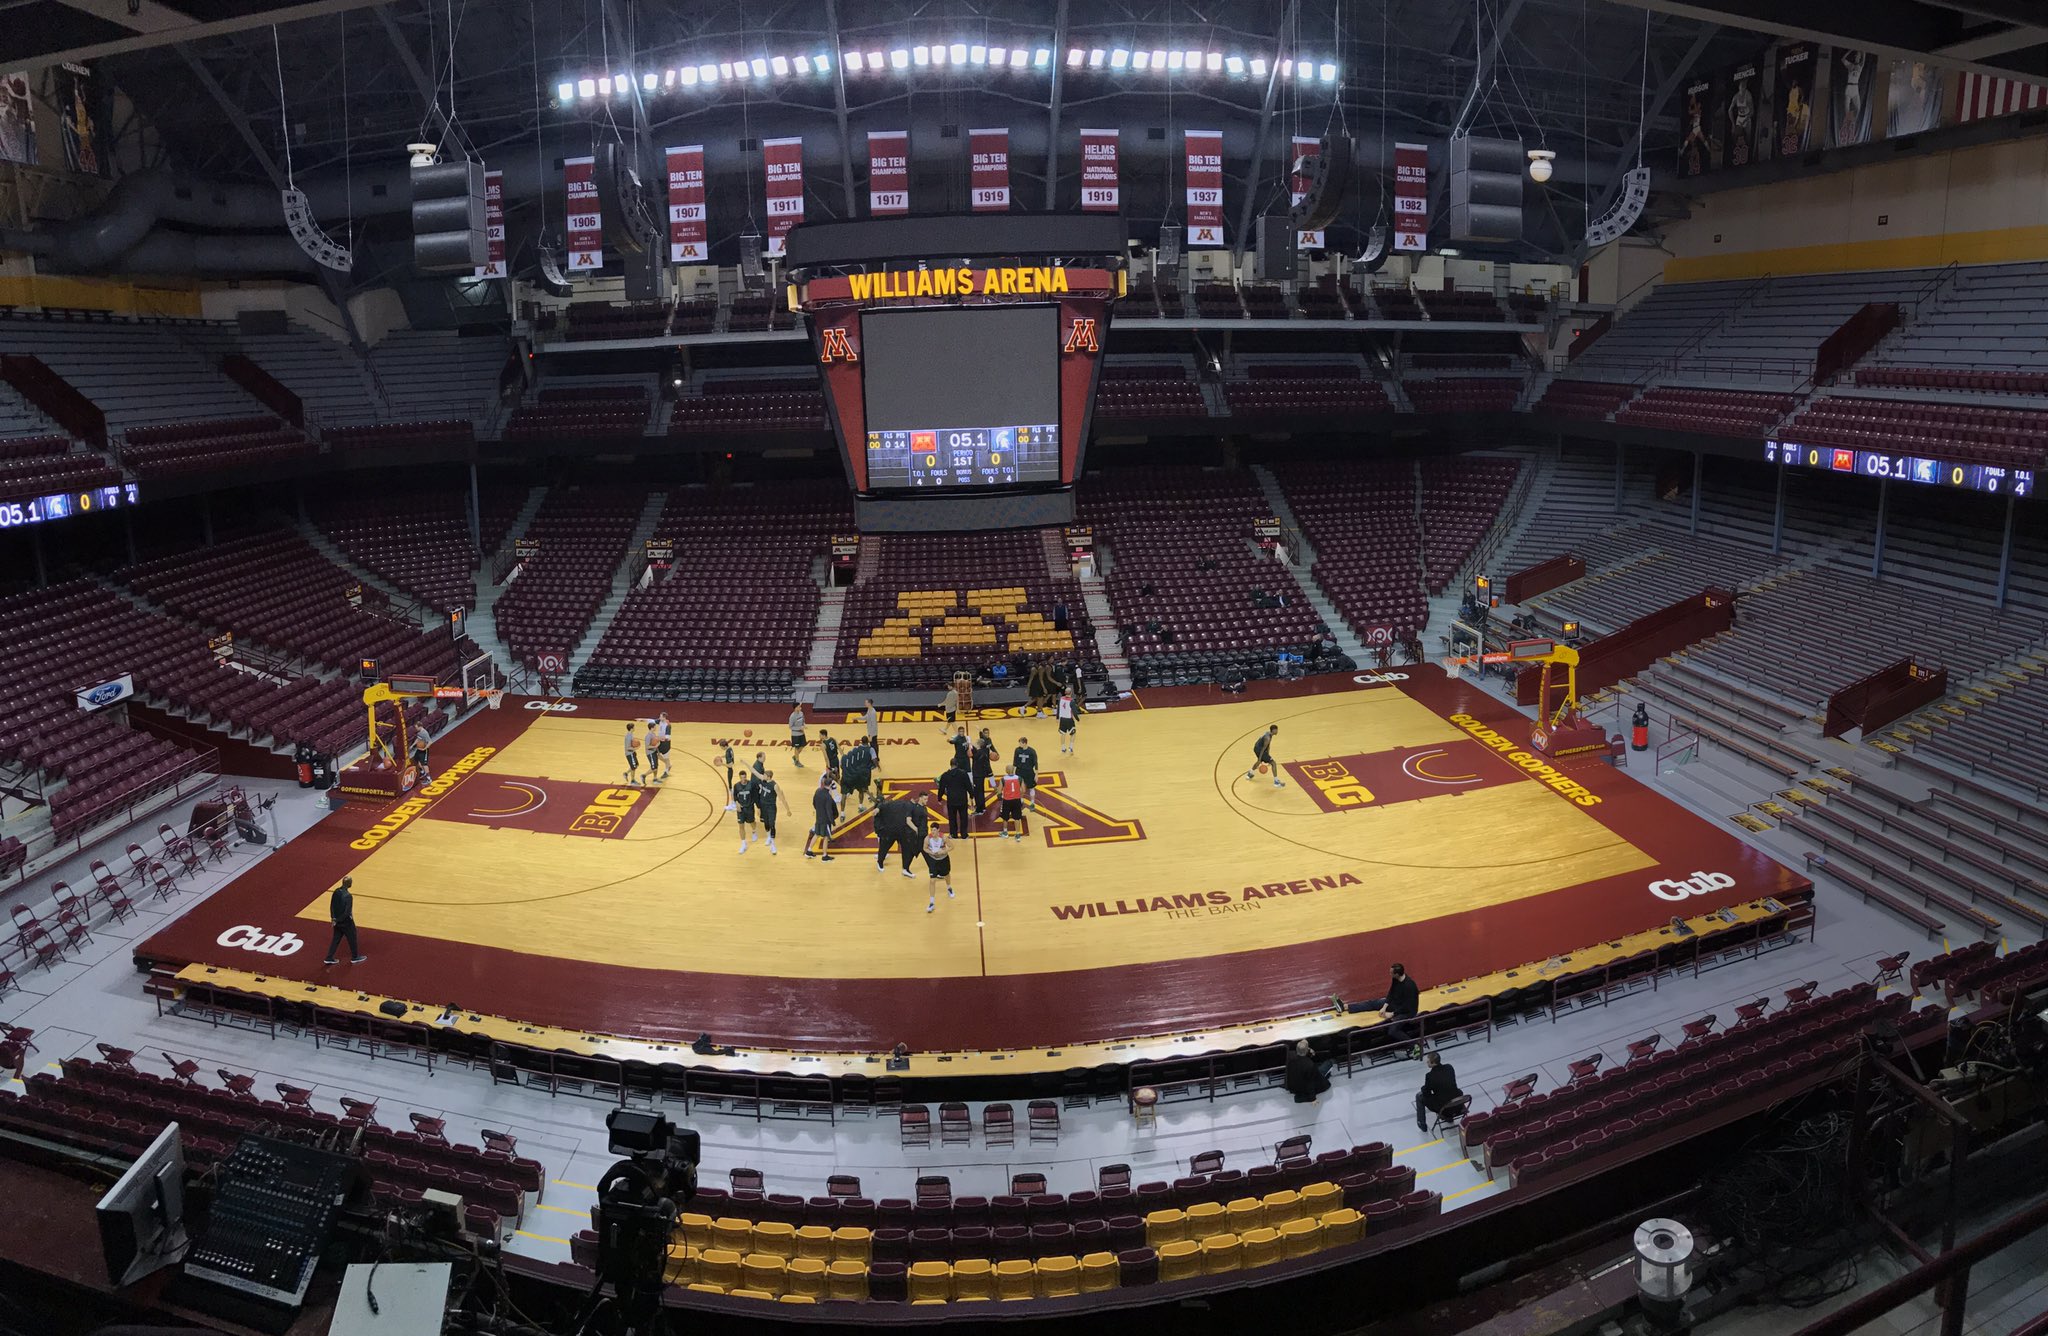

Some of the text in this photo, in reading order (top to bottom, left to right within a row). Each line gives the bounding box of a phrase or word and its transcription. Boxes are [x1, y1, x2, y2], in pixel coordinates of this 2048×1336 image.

[1785, 51, 1809, 66] TUCKER
[1085, 145, 1116, 155] HELMS
[872, 157, 906, 167] BIG TEN
[973, 153, 1007, 164] BIG TEN
[1188, 155, 1221, 165] BIG TEN
[768, 163, 801, 174] BIG TEN
[973, 164, 1008, 172] CHAMPIONS
[1397, 166, 1426, 176] BIG TEN
[670, 171, 702, 182] BIG TEN
[768, 173, 802, 182] CHAMPIONS
[1397, 175, 1426, 183] CHAMPIONS
[568, 182, 582, 192] BIG
[670, 181, 703, 189] CHAMPIONS
[568, 191, 598, 199] CHAMPIONS
[876, 194, 902, 205] 1917
[978, 191, 1004, 202] 1919
[1088, 191, 1113, 202] 1919
[1193, 191, 1217, 202] 1937
[773, 200, 797, 211] 1911
[1400, 200, 1422, 210] 1982
[675, 207, 700, 218] 1907
[573, 217, 596, 227] 1906
[489, 228, 500, 238] 02
[1197, 229, 1215, 241] M
[1402, 235, 1419, 246] M
[680, 245, 698, 257] M
[577, 254, 594, 265] M
[848, 267, 1069, 300] WILLIAMS ARENA
[1064, 318, 1099, 352] M
[821, 328, 857, 363] M
[949, 432, 987, 448] 05.1
[1018, 435, 1029, 443] 00
[1033, 435, 1039, 443] 4
[869, 441, 880, 449] 00
[1782, 443, 1797, 451] FOULS
[953, 449, 974, 457] PERIOD
[1767, 450, 1792, 464] 4 0
[1809, 450, 1818, 465] 0
[926, 453, 1001, 467] 0 1ST 0
[1866, 455, 1906, 478] 05.1
[1985, 466, 2005, 477] FOULS
[930, 469, 948, 477] FOULS
[1952, 467, 1964, 485] 0
[916, 478, 923, 486] 4
[936, 477, 942, 485] 0
[988, 476, 994, 484] 0
[1988, 478, 2025, 495] 0 4
[104, 486, 120, 495] FOULS
[80, 494, 90, 510] 0
[109, 491, 136, 507] 0 4
[0, 501, 41, 527] 05.1
[1353, 672, 1410, 684] Cub
[94, 687, 117, 703] Ford
[524, 701, 578, 712] Cub
[1534, 733, 1548, 745] DQ
[1555, 743, 1605, 756] GOPHERSPORTS.com
[1450, 713, 1603, 806] GOLDEN GOPHERS
[403, 770, 416, 786] DQ
[340, 786, 395, 796] GOPHERSPORTS.com
[350, 746, 496, 850] GOLDEN GOPHERS
[1648, 870, 1736, 901] Cub
[1050, 872, 1363, 921] WILLIAMS ARENA
[1164, 900, 1262, 920] THE BARN
[216, 924, 304, 957] Cub
